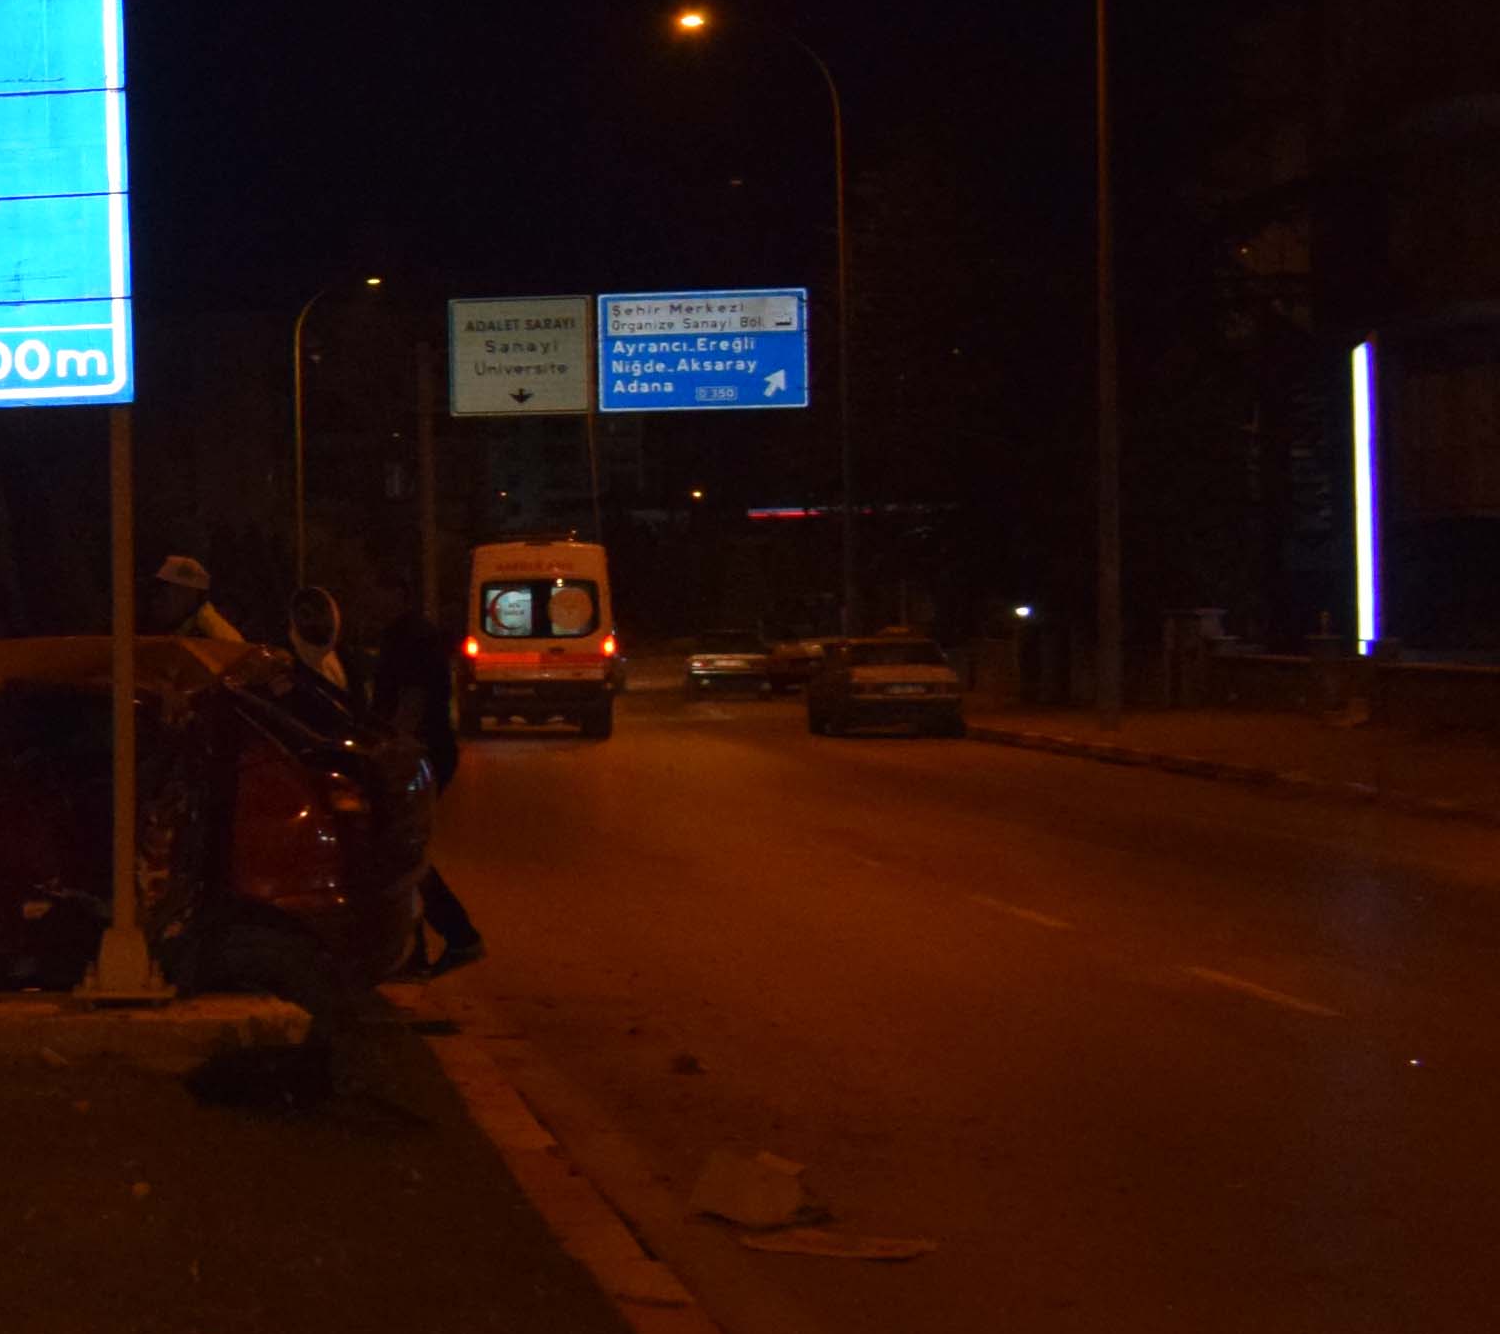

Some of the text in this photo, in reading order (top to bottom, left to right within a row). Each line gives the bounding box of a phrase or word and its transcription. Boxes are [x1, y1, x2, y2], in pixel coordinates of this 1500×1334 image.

[669, 301, 744, 316] Merkezi
[484, 339, 559, 355] Sanayi
[613, 380, 675, 394] Adana
